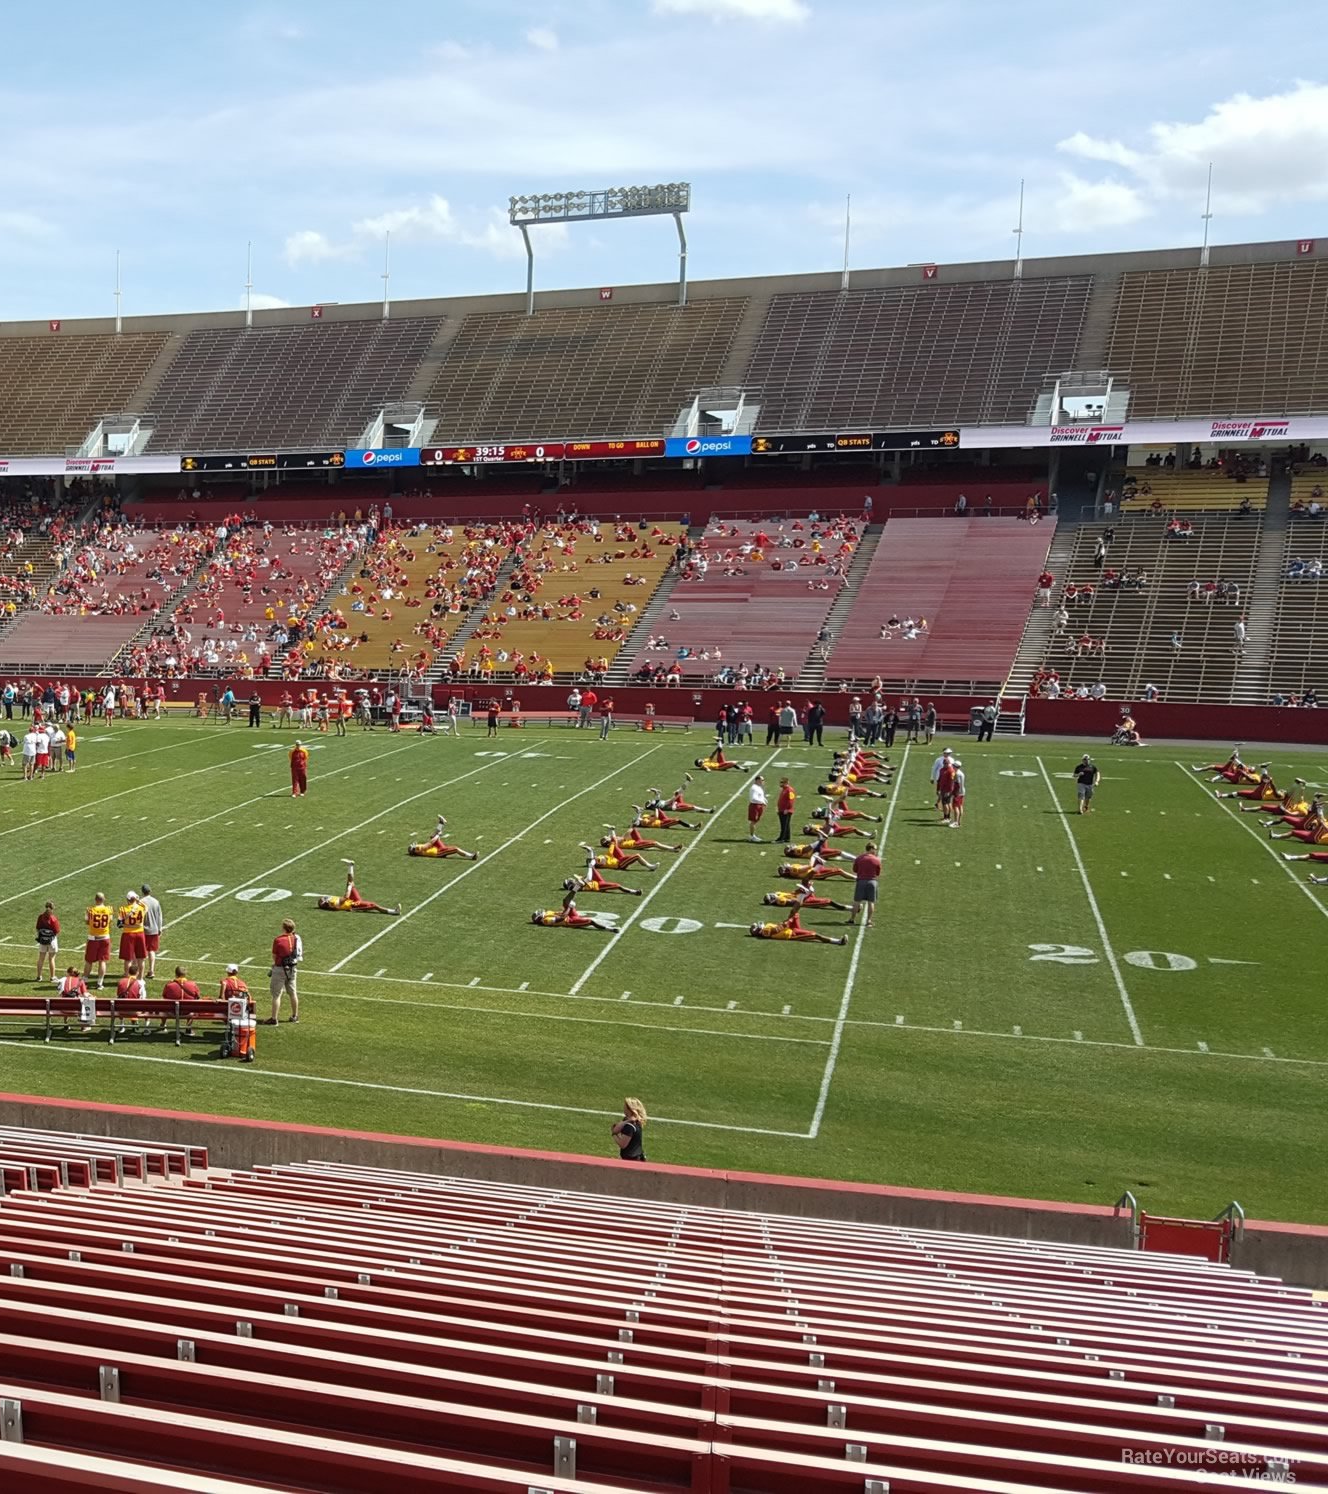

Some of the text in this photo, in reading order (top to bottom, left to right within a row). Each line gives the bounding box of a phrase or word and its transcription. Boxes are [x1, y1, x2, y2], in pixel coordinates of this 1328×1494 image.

[1051, 427, 1089, 435] Discover
[1211, 422, 1251, 430] Discover
[1050, 432, 1122, 442] GRINNELL MUTUAL
[1210, 428, 1289, 438] GRINNELL MUTUAL
[702, 441, 731, 452] pepsi
[376, 453, 402, 463] pepsi
[434, 450, 443, 460] 0
[476, 447, 505, 456] 39:15
[536, 447, 544, 457] 0
[93, 914, 109, 928] 58
